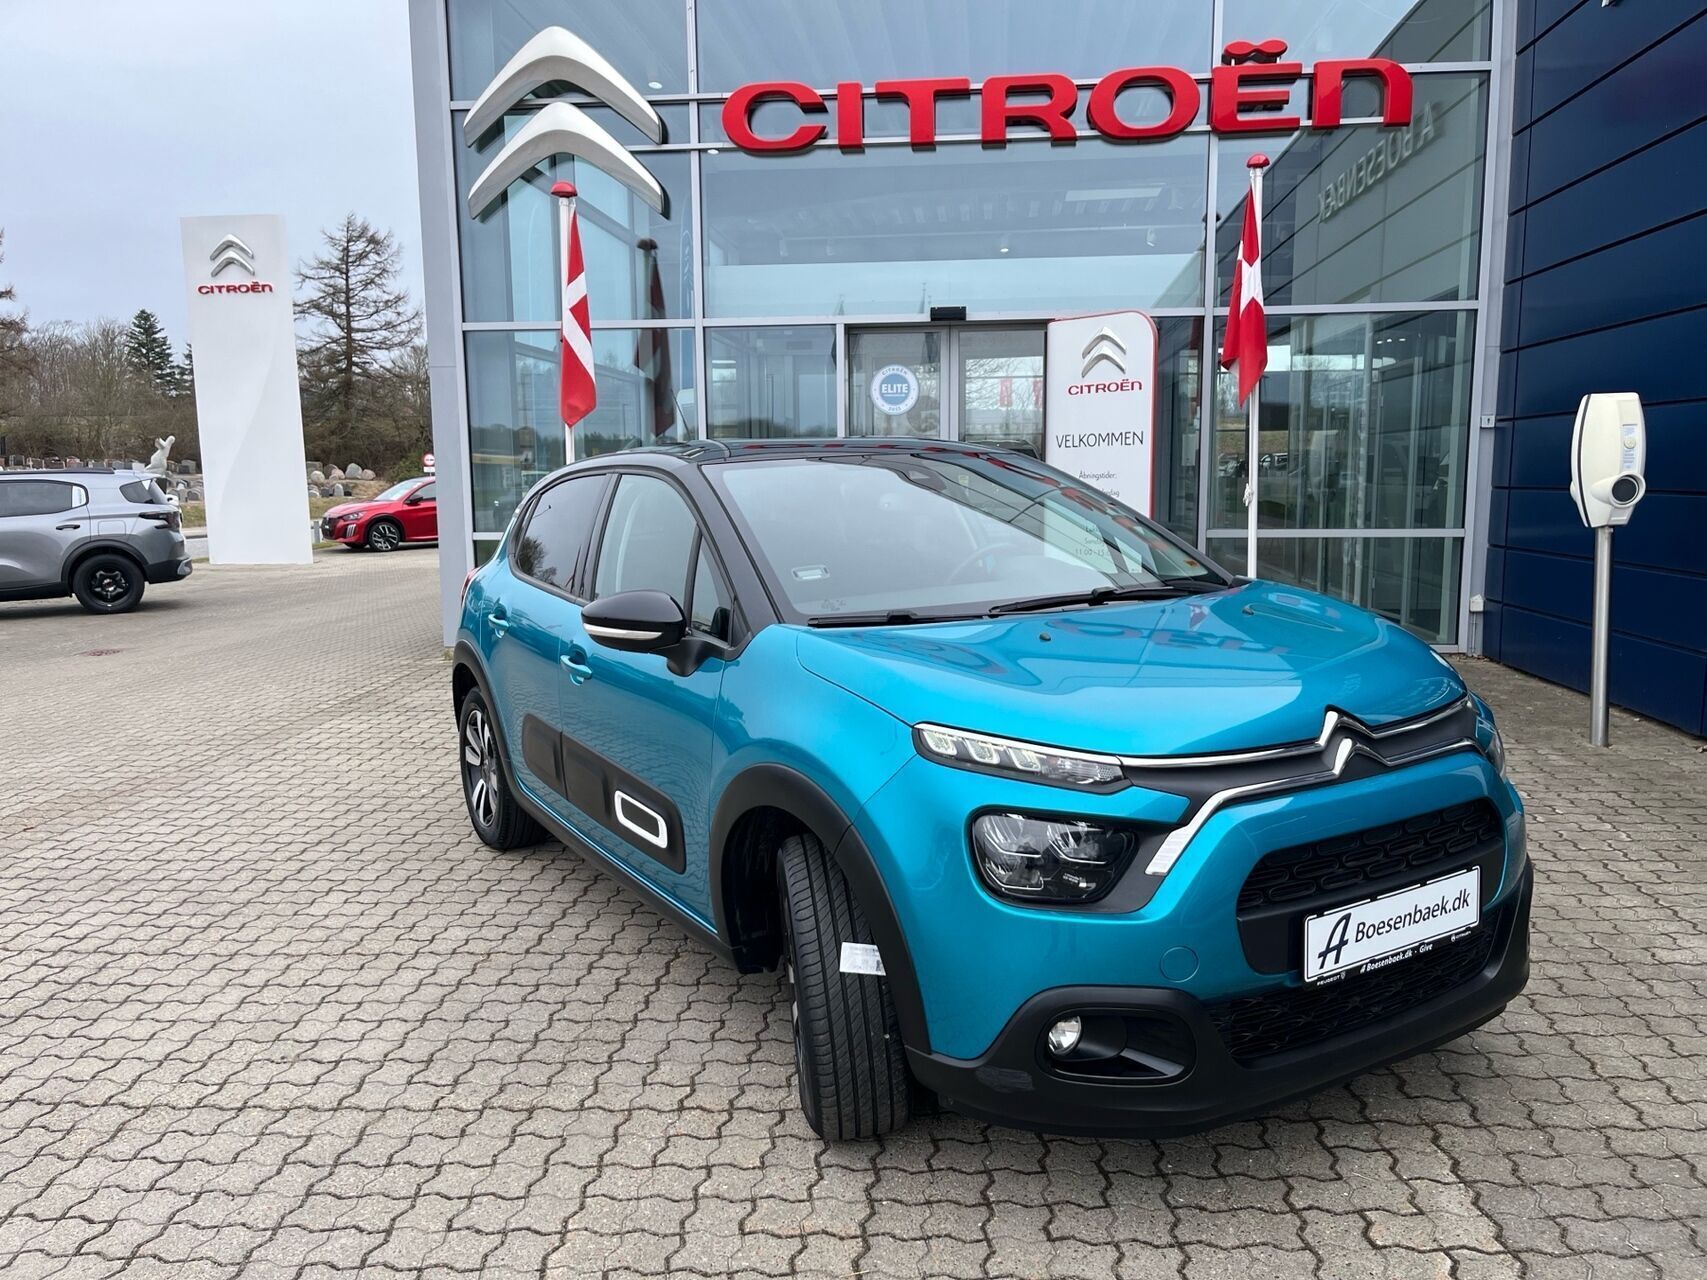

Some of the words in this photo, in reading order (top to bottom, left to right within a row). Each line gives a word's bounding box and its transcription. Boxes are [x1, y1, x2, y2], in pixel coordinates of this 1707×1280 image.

[881, 383, 909, 394] ELITE
[1056, 430, 1144, 449] VELKOMMEN
[1355, 888, 1471, 943] Boesenbaek.dk
[1366, 950, 1413, 972] Boesenbaek.dk
[1420, 943, 1433, 953] Give
